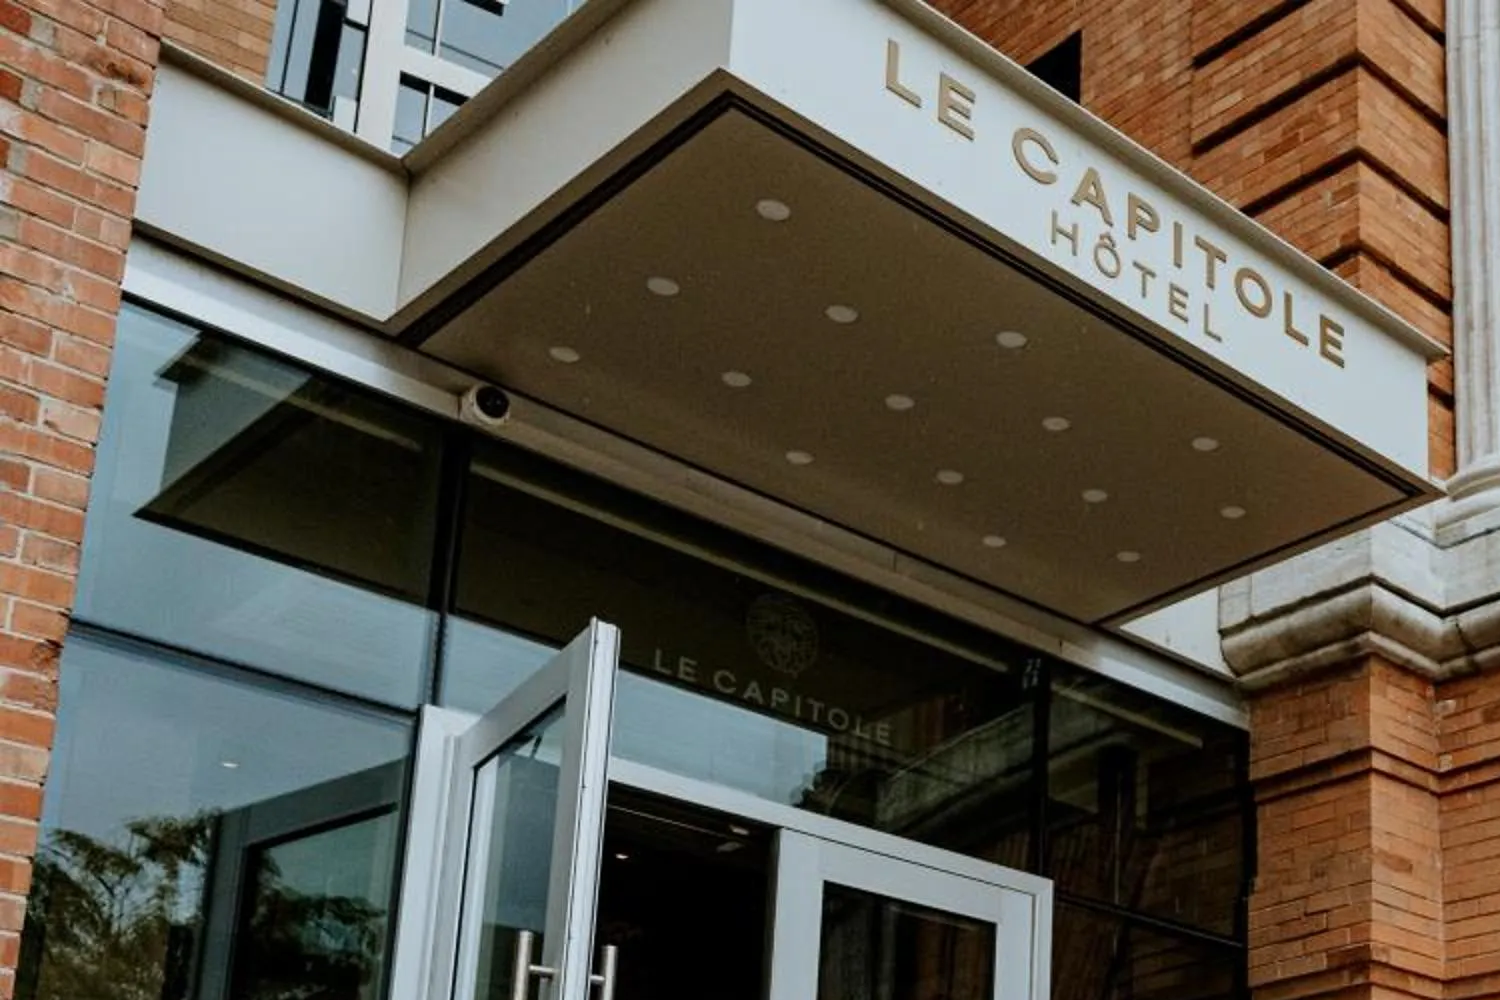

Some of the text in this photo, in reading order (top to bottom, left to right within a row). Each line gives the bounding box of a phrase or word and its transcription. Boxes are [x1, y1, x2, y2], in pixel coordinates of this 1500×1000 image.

[886, 38, 1345, 368] LE CAPITOLE
[1051, 211, 1222, 342] HÔTEL
[655, 648, 891, 744] LE CAPITOLE
